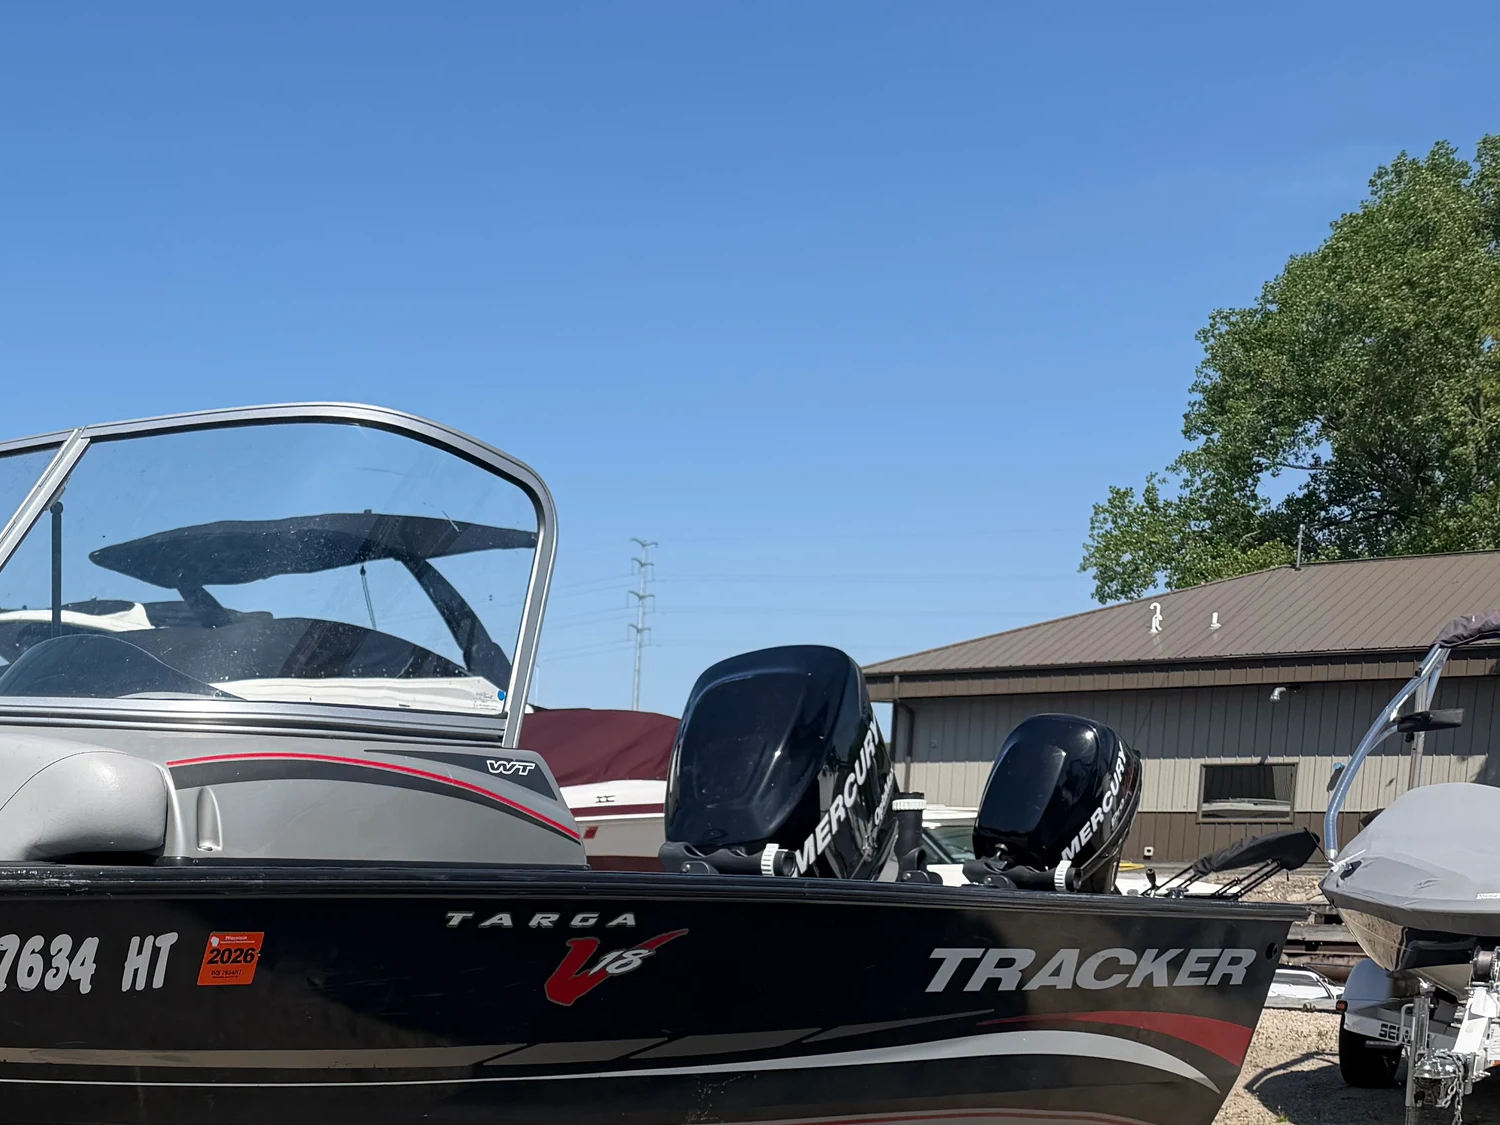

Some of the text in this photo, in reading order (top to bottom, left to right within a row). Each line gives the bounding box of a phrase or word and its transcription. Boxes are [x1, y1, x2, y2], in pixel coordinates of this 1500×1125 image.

[486, 760, 535, 776] WT
[794, 720, 879, 875] MERCURY
[1061, 741, 1127, 861] MERCURY
[446, 912, 637, 928] TARGA
[121, 932, 179, 992] HT
[206, 947, 256, 964] 2026
[924, 948, 1257, 992] TRACKER
